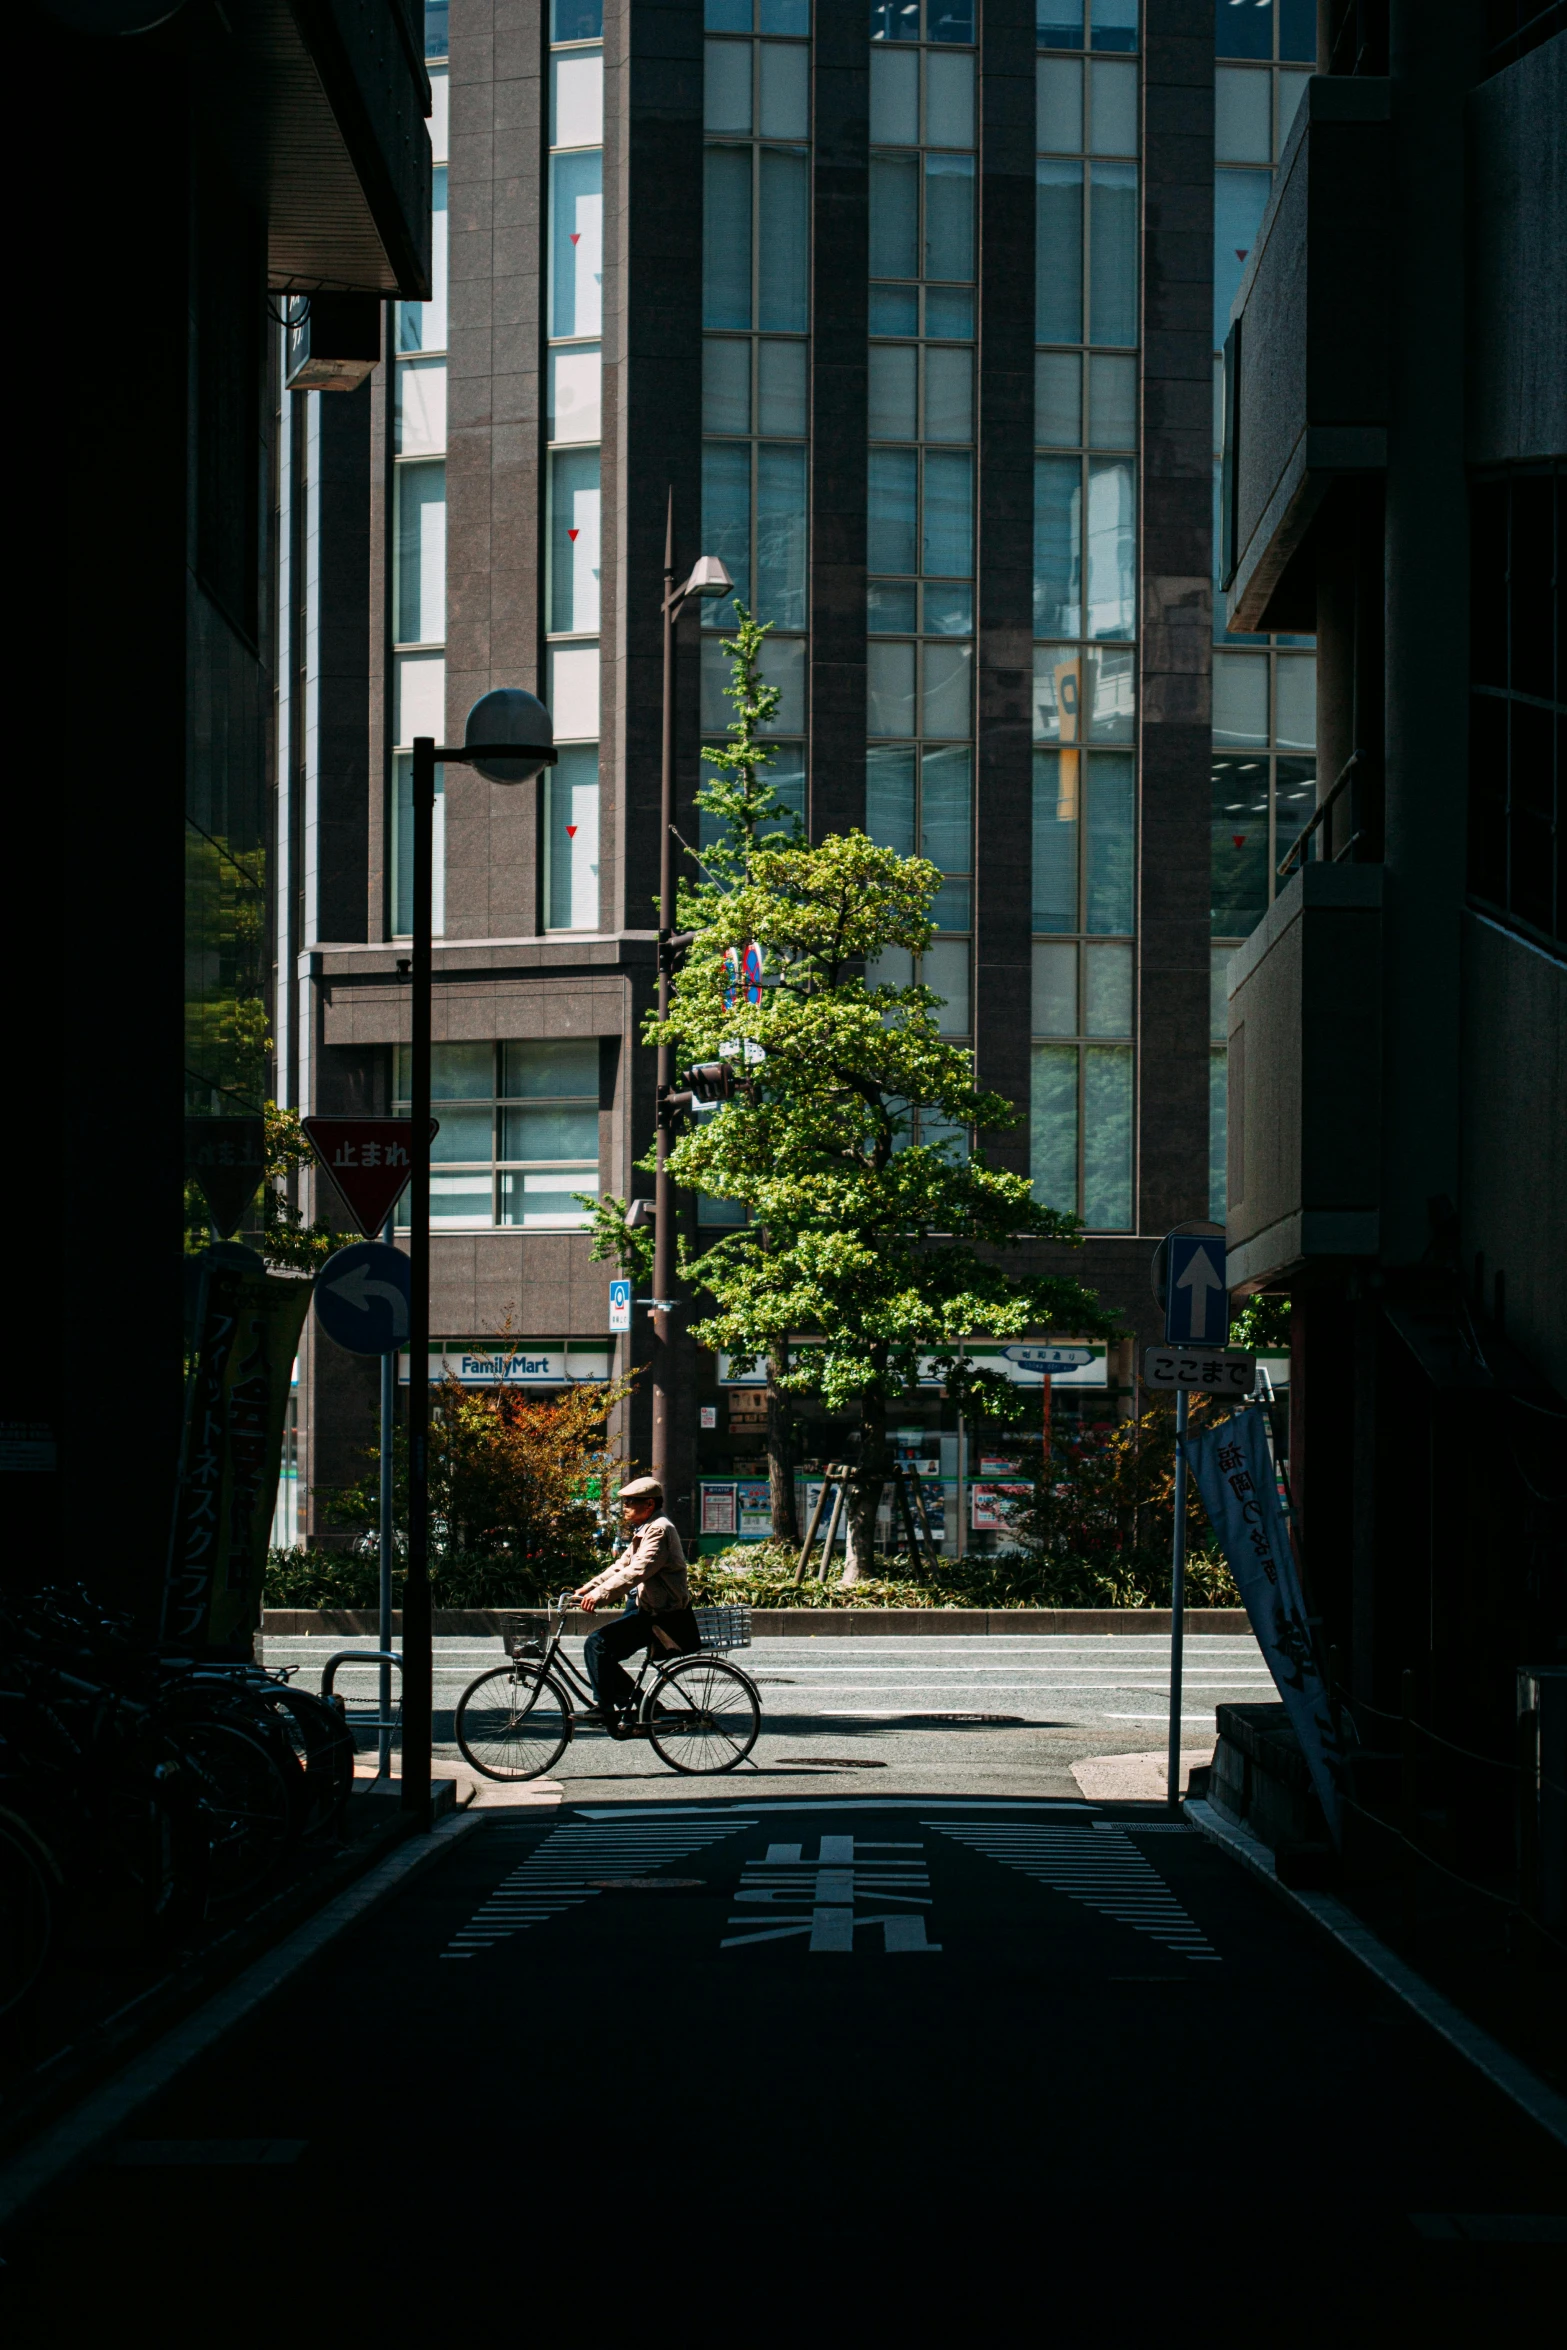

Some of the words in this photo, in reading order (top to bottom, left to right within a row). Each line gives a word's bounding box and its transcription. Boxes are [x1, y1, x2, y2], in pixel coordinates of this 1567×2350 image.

[332, 1140, 410, 1167] 止まれ
[461, 1356, 549, 1377] FamilyMart
[1154, 1358, 1248, 1385] ここまで
[177, 1312, 234, 1637] フィットネスクラブ
[719, 1834, 943, 1953] 止まれ
